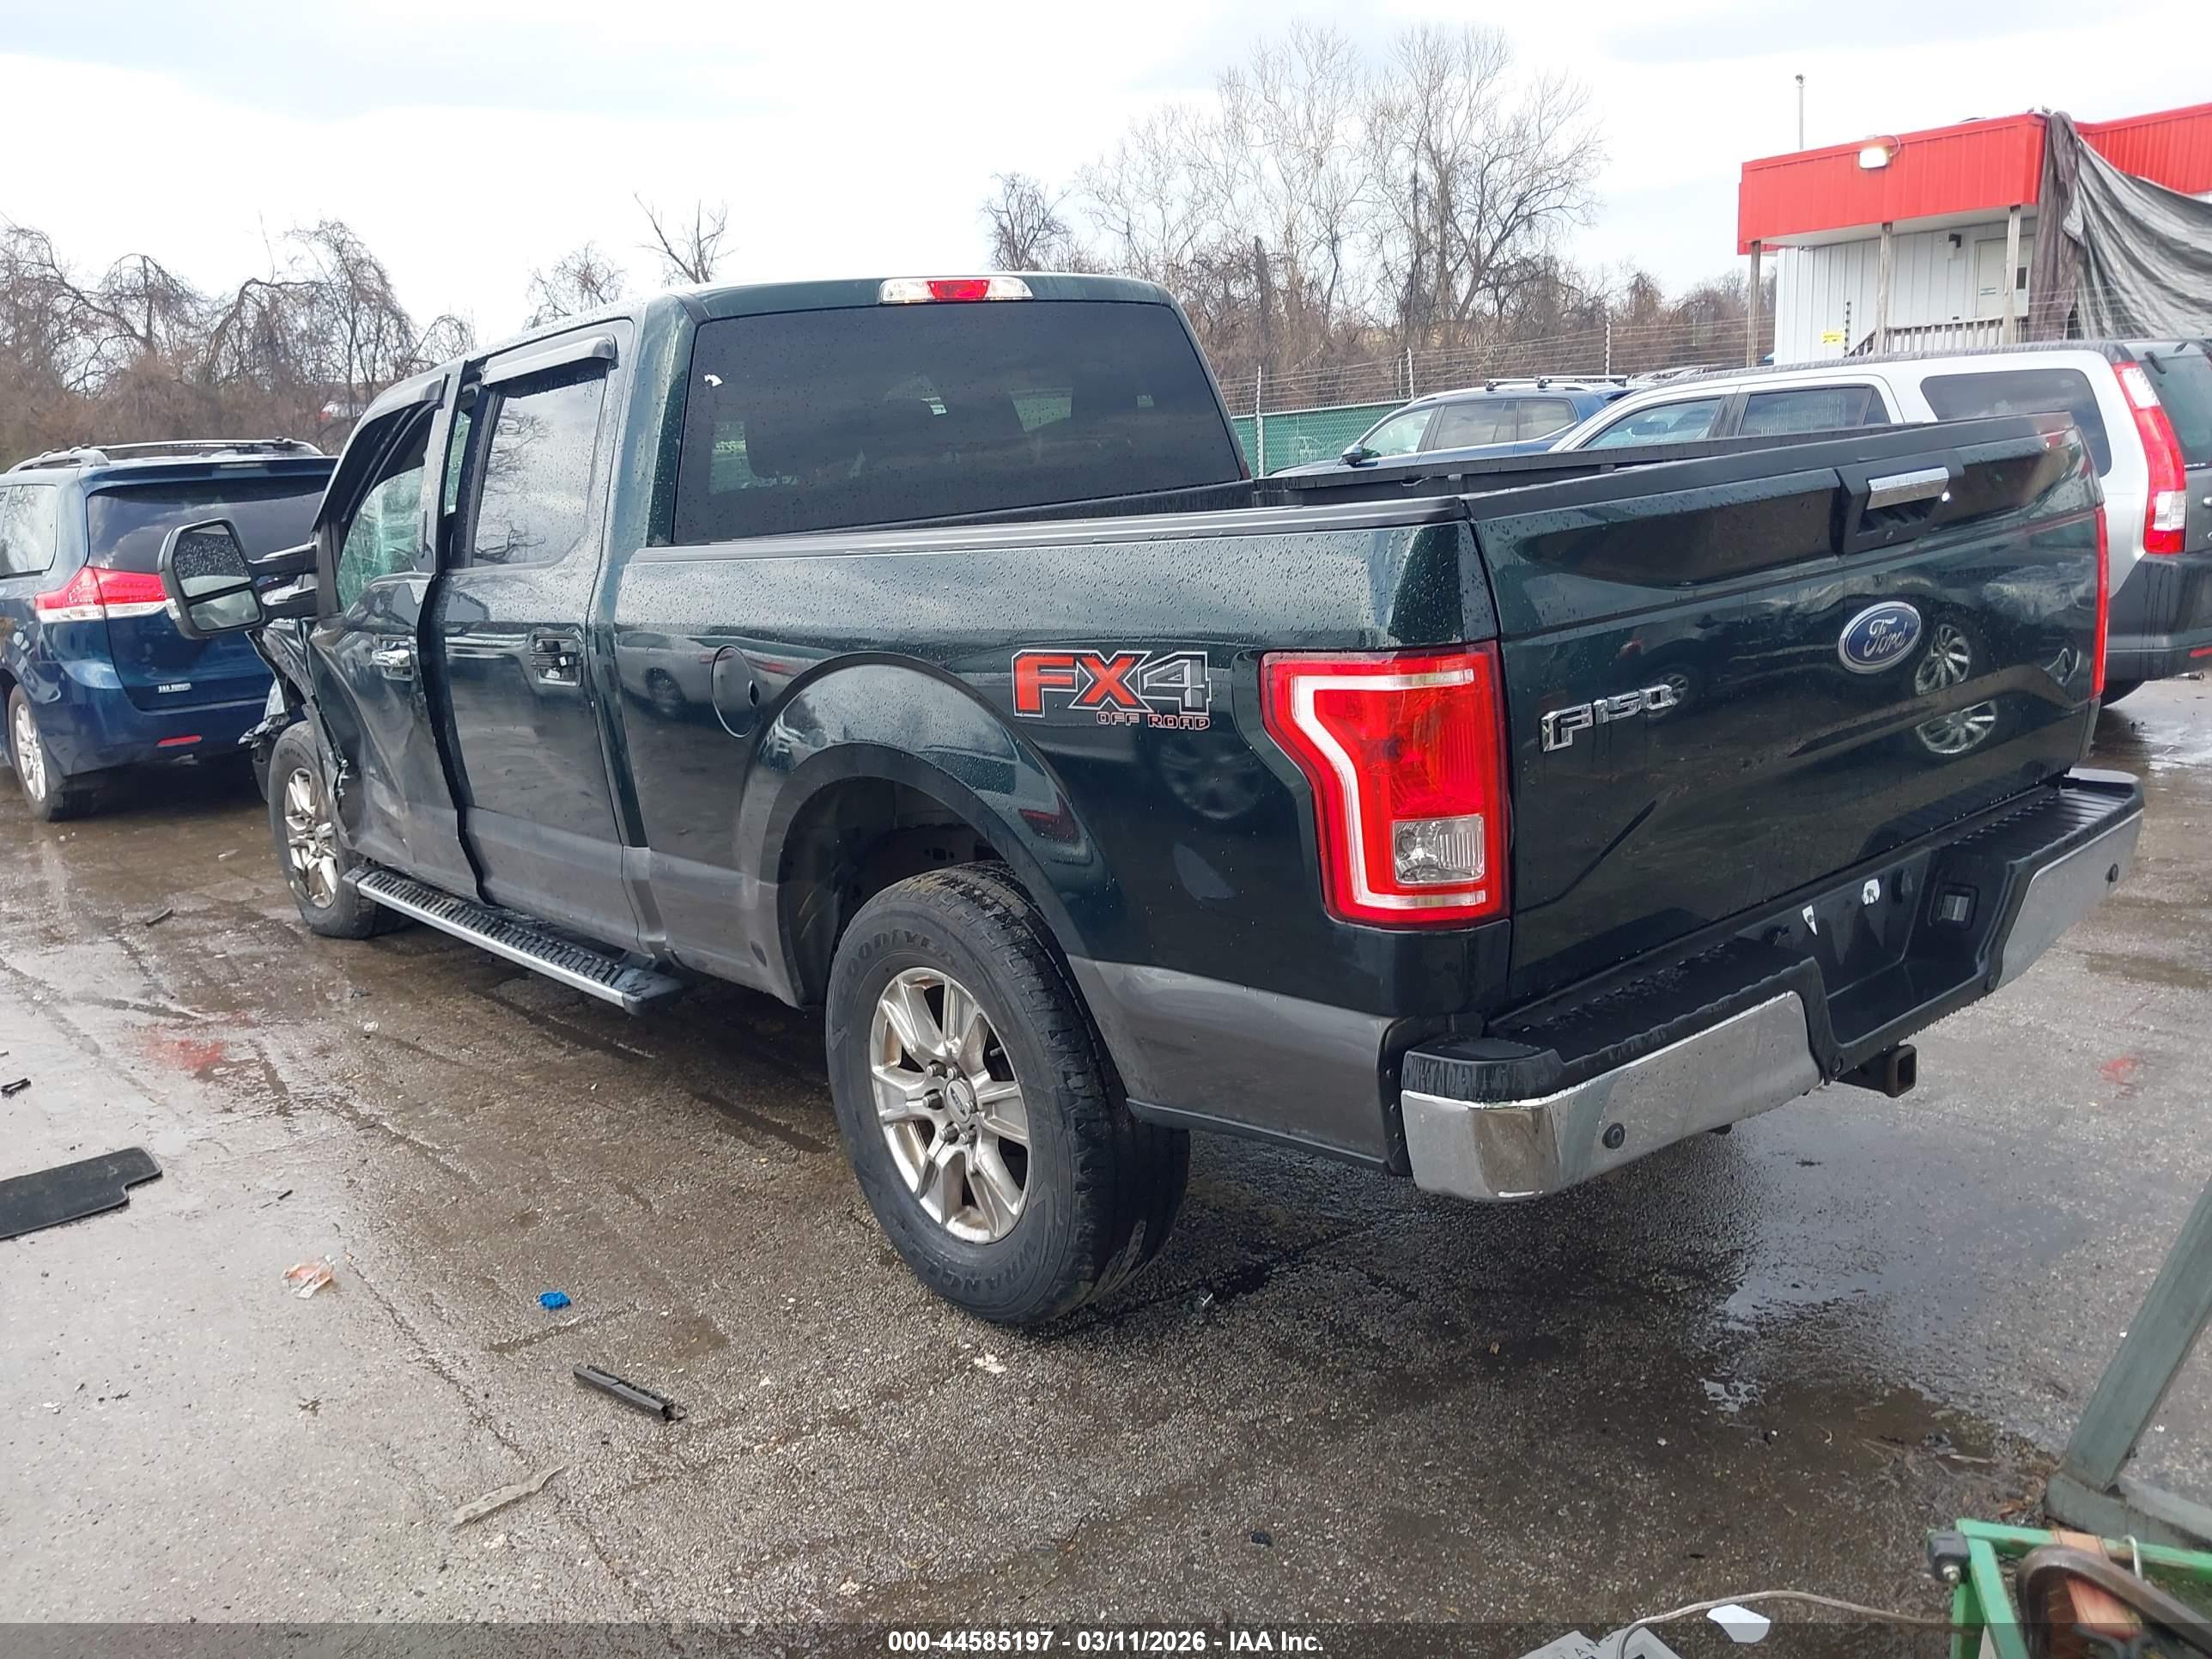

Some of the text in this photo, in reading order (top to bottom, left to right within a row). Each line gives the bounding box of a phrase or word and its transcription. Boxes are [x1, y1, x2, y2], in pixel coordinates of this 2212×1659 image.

[1864, 616, 1908, 659] Ford
[1012, 650, 1212, 718] FX4
[1096, 711, 1211, 731] OFF ROAD
